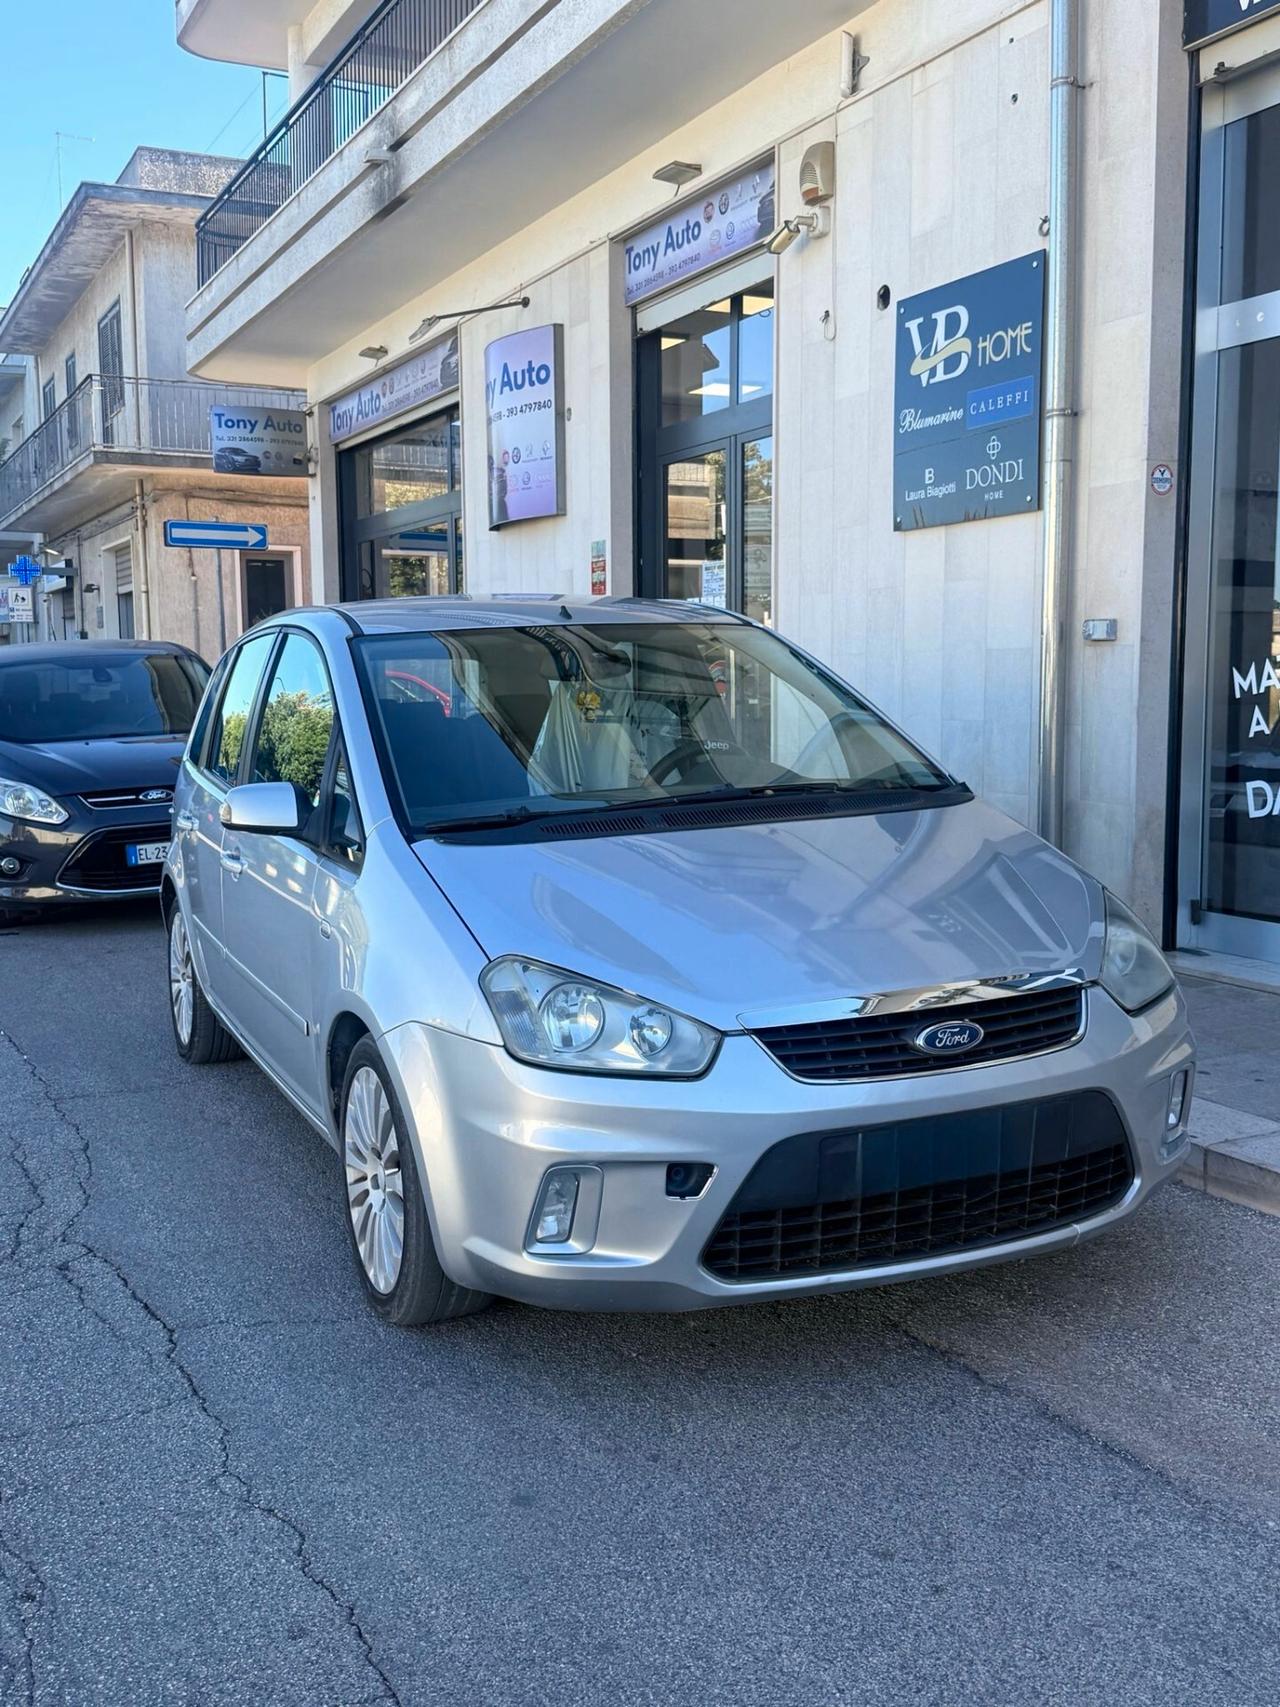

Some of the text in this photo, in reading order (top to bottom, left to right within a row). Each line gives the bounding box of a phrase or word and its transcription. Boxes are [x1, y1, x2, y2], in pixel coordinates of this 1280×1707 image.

[625, 219, 702, 275] Tony Auto
[977, 321, 1033, 367] HOME
[500, 360, 551, 396] Auto
[331, 404, 354, 434] Tony
[356, 391, 380, 423] Auto
[506, 406, 518, 418] 393
[519, 399, 553, 414] 4797840
[970, 390, 1029, 415] CALEFFI
[214, 413, 303, 434] Tony Auto
[900, 406, 964, 433] Blumarine
[966, 459, 1024, 490] DONDI
[905, 481, 957, 501] Laura Biagiotti
[984, 490, 1004, 501] HOME
[1248, 704, 1270, 738] A
[704, 741, 730, 751] Jeep
[147, 791, 167, 799] Ford
[1246, 780, 1280, 819] D
[935, 1027, 970, 1047] Ford
